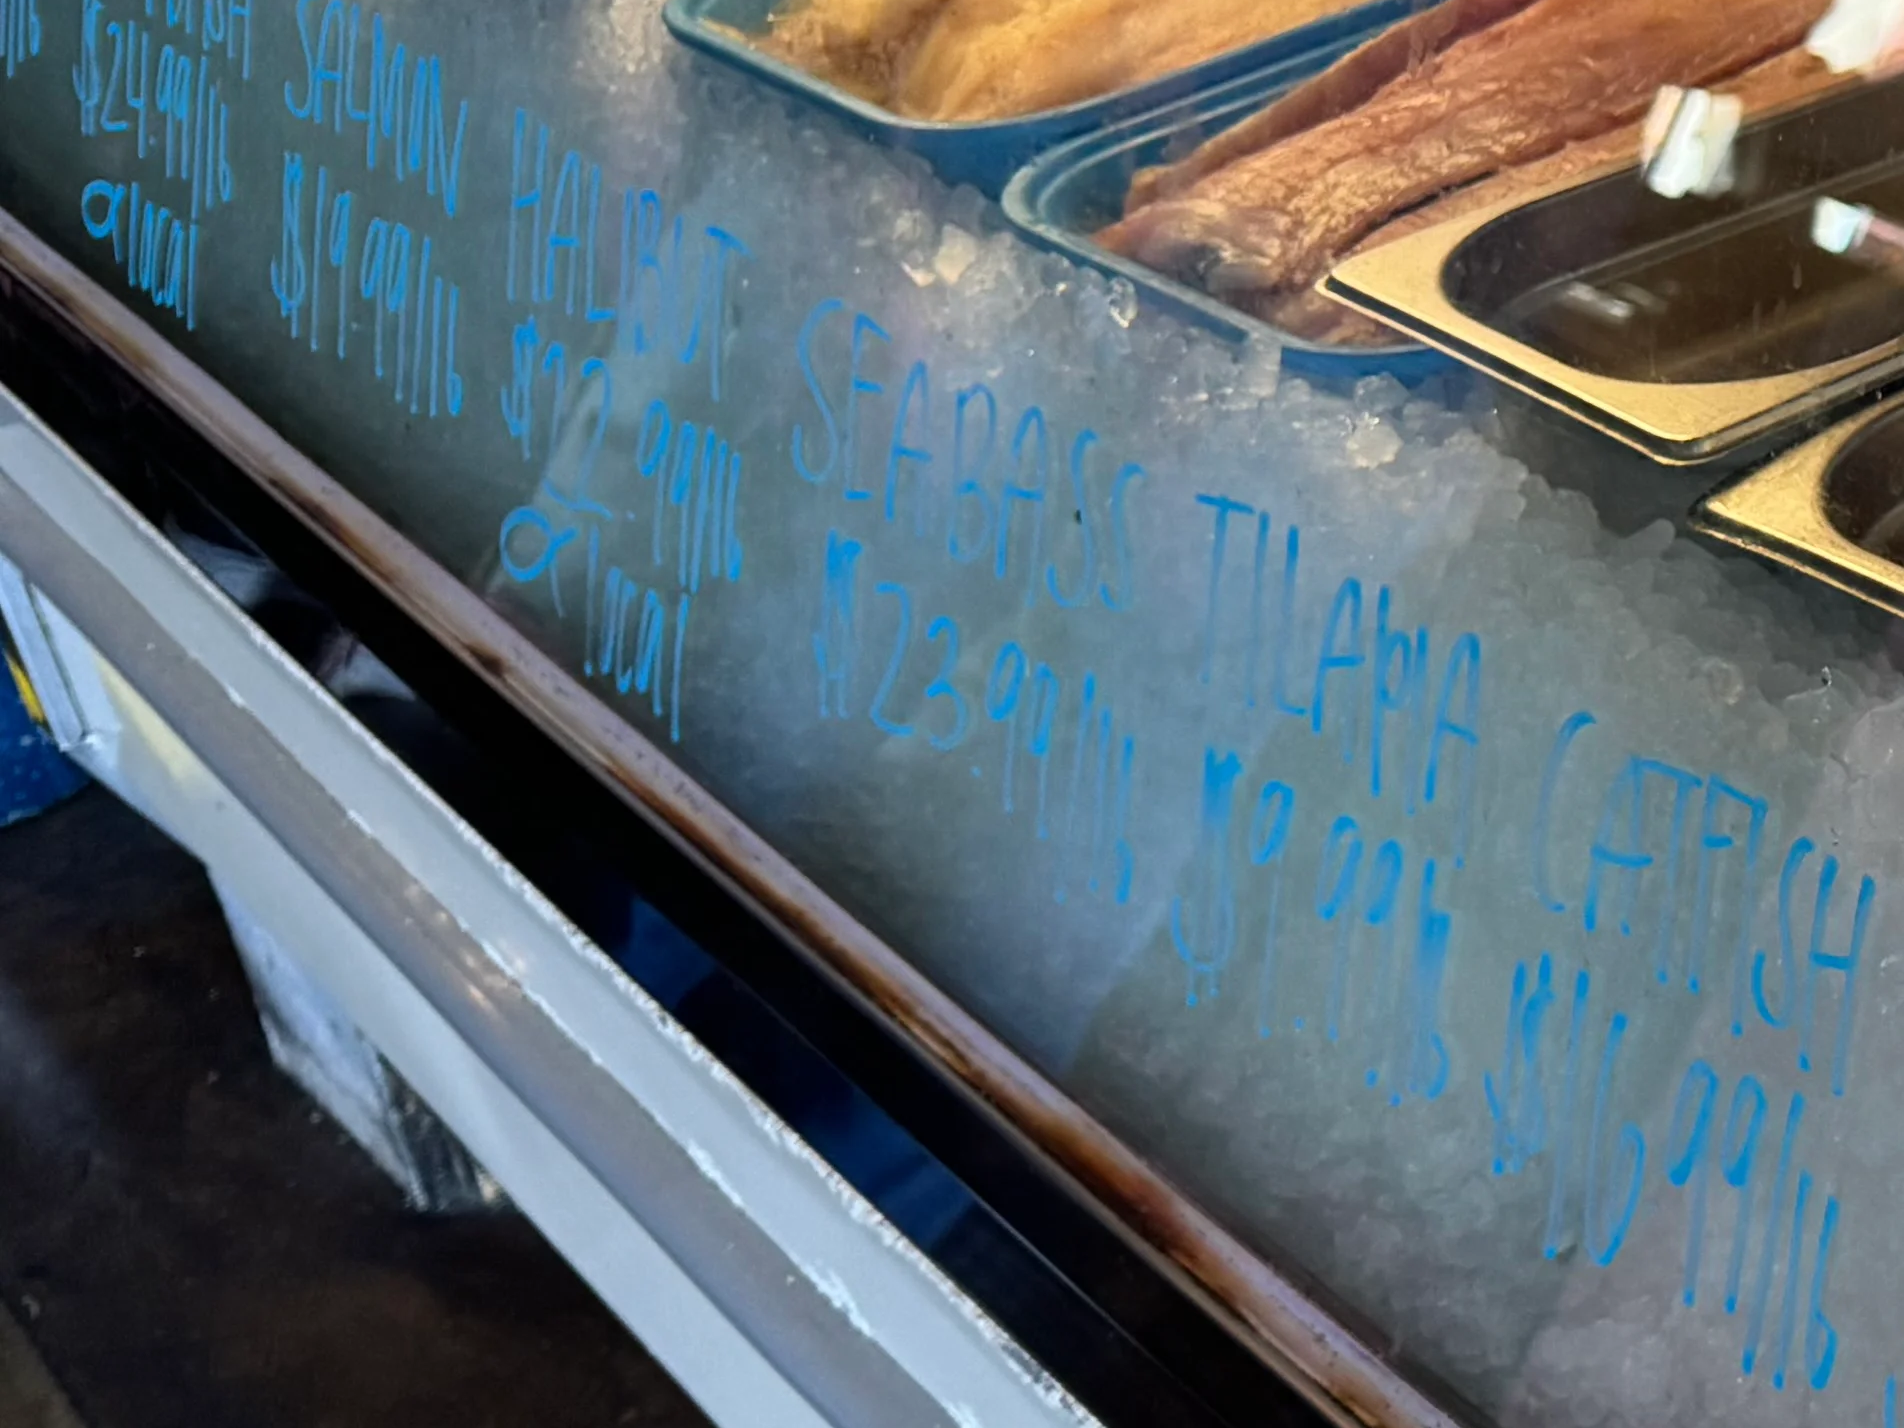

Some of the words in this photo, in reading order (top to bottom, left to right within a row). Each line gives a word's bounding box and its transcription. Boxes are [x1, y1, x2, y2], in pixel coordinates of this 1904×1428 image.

[507, 106, 755, 403] HALIBUT
[1195, 492, 1481, 870] TILAPIA
[1532, 711, 1875, 1097] CATFISH
